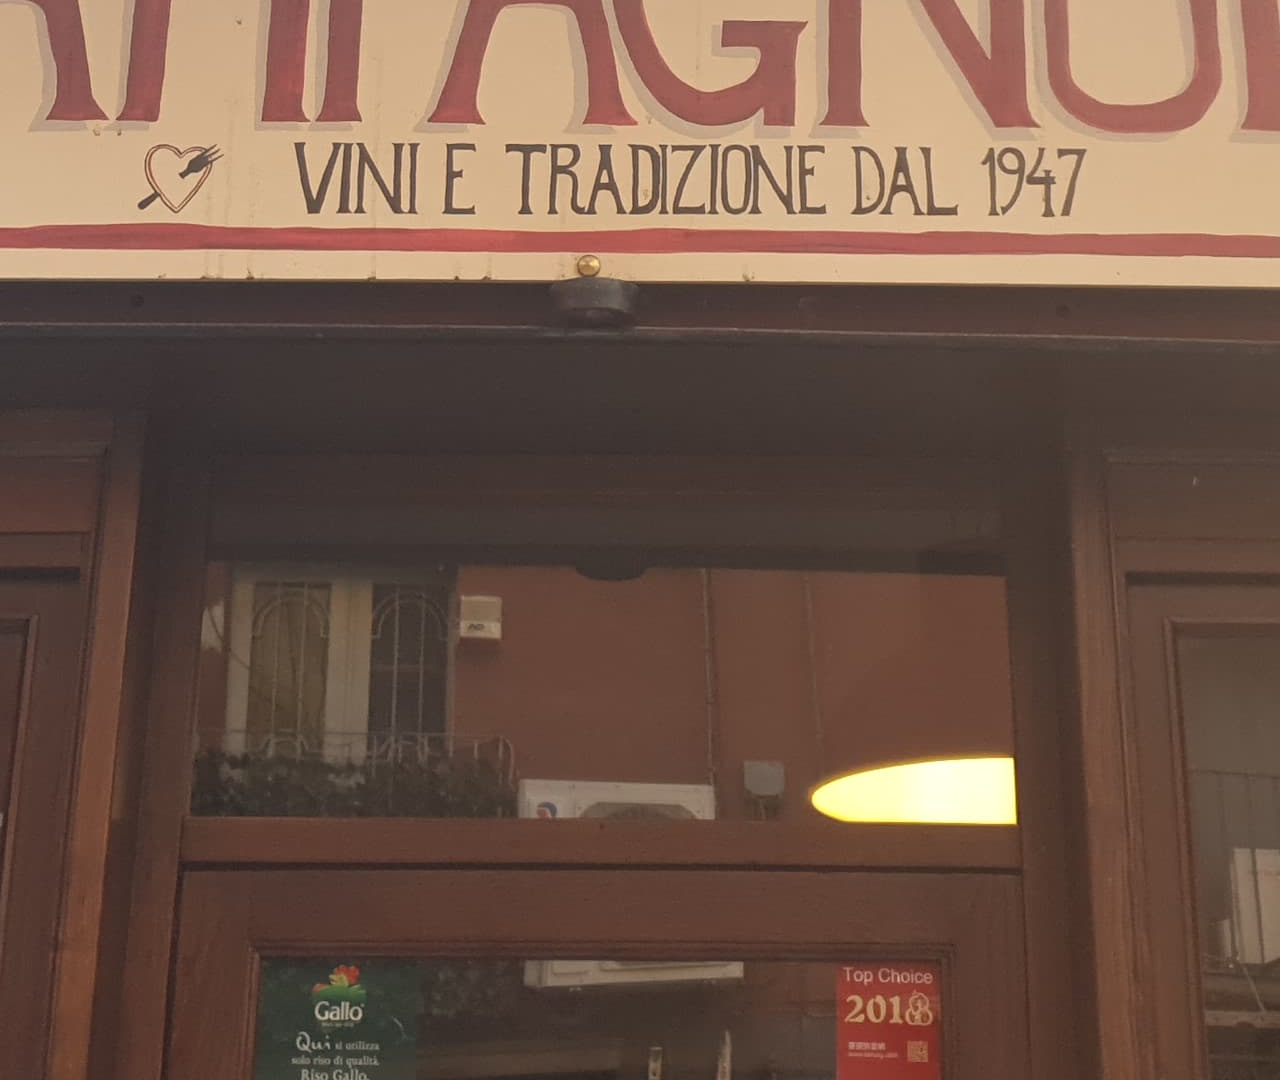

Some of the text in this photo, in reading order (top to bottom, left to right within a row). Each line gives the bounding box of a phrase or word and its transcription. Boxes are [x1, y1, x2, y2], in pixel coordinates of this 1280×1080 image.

[293, 142, 1088, 218] VINI E TRADIZIONE DAL 1947
[843, 966, 934, 987] Top Choice
[314, 1000, 363, 1021] Gallo
[844, 989, 934, 1026] 2018
[296, 1031, 331, 1053] Qui
[346, 1040, 380, 1050] utilizza
[291, 1055, 311, 1065] solo
[313, 1056, 331, 1065] riso
[333, 1055, 343, 1065] di
[300, 1068, 329, 1080] Riso
